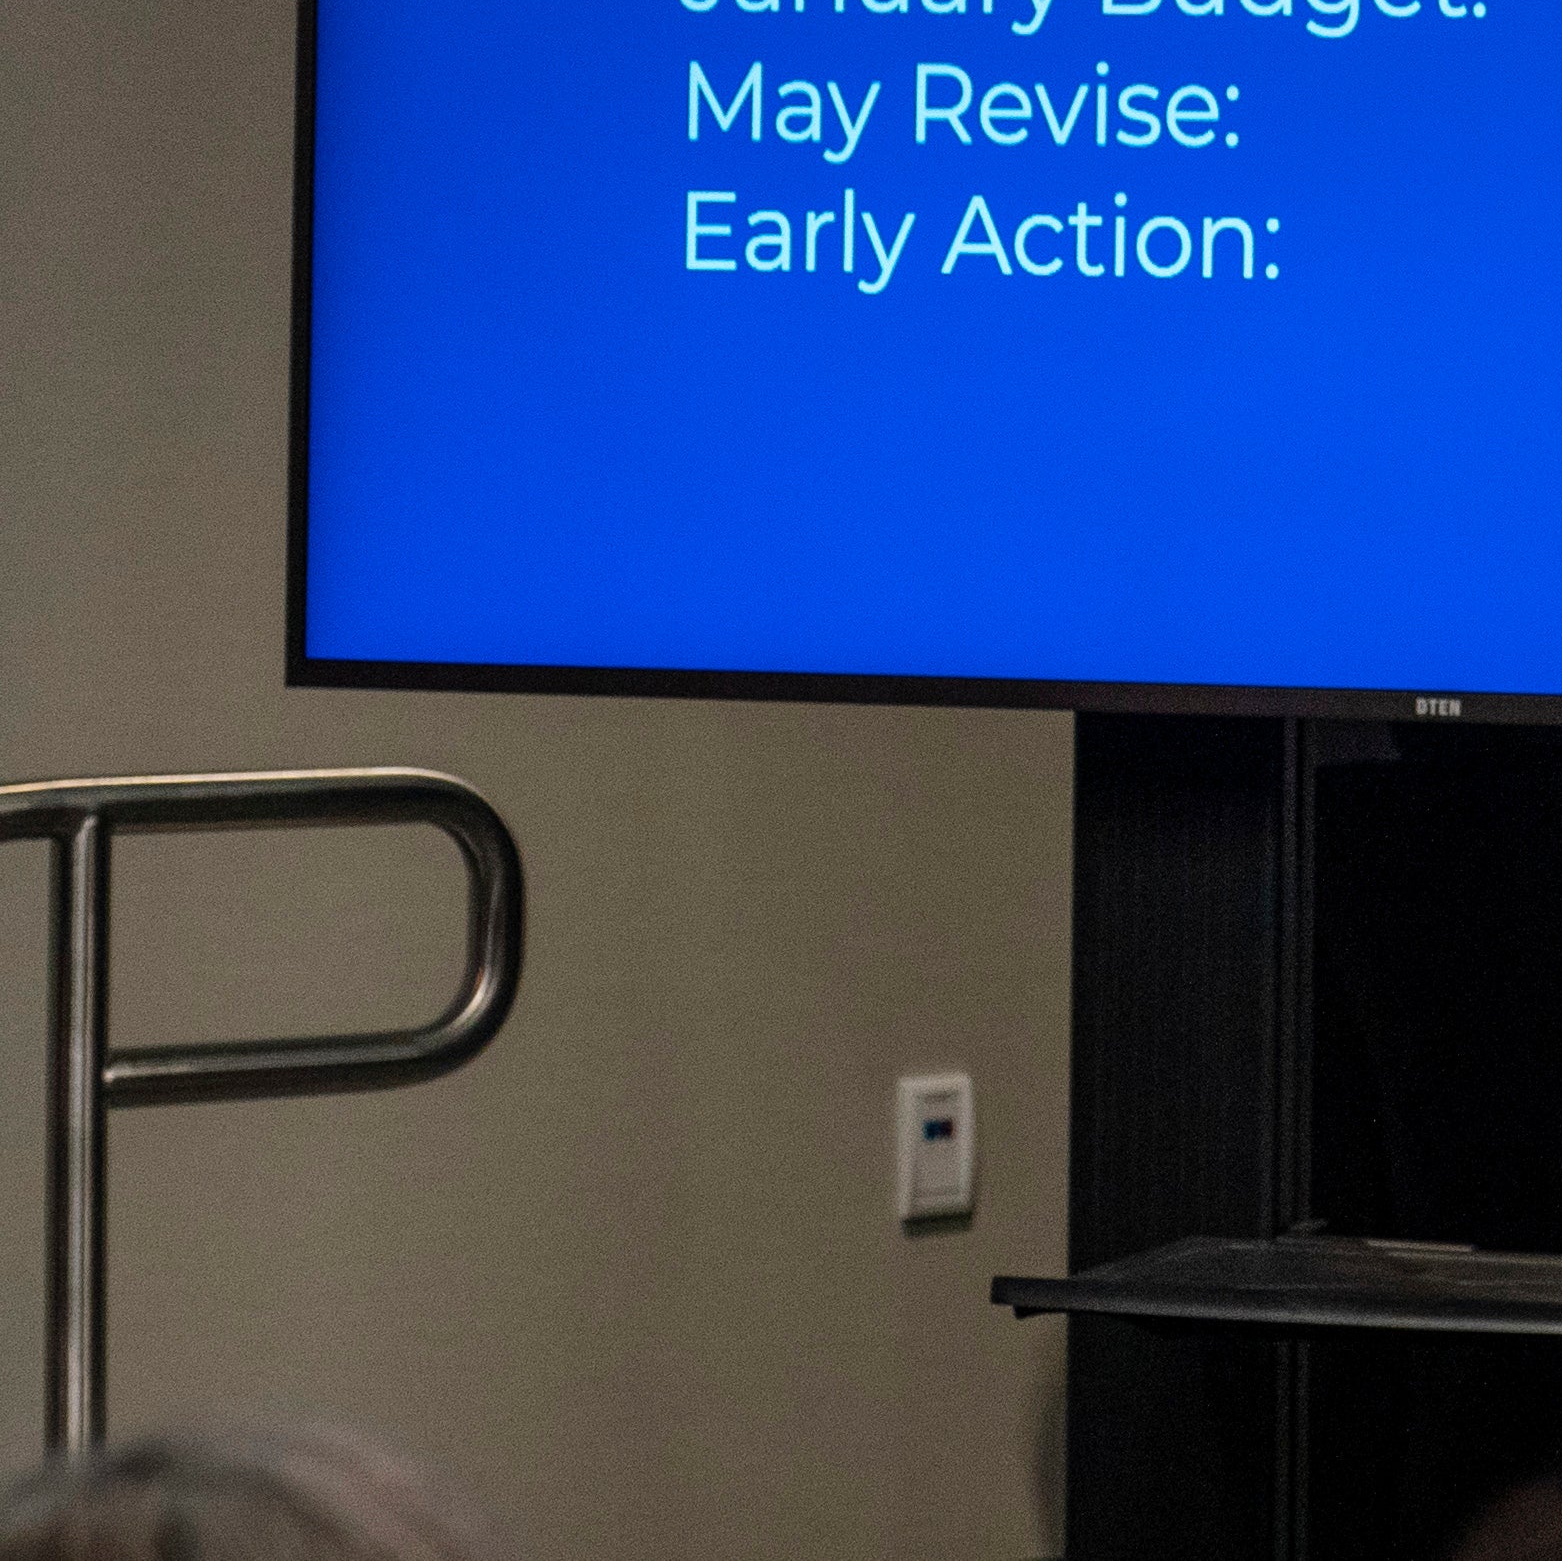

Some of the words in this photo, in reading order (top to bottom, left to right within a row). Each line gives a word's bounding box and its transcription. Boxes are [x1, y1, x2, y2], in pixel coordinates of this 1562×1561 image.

[688, 61, 881, 163] May
[916, 62, 1240, 147] Revise:
[685, 189, 915, 294] Early
[941, 193, 1280, 279] Action:
[1414, 696, 1462, 717] DTEN
